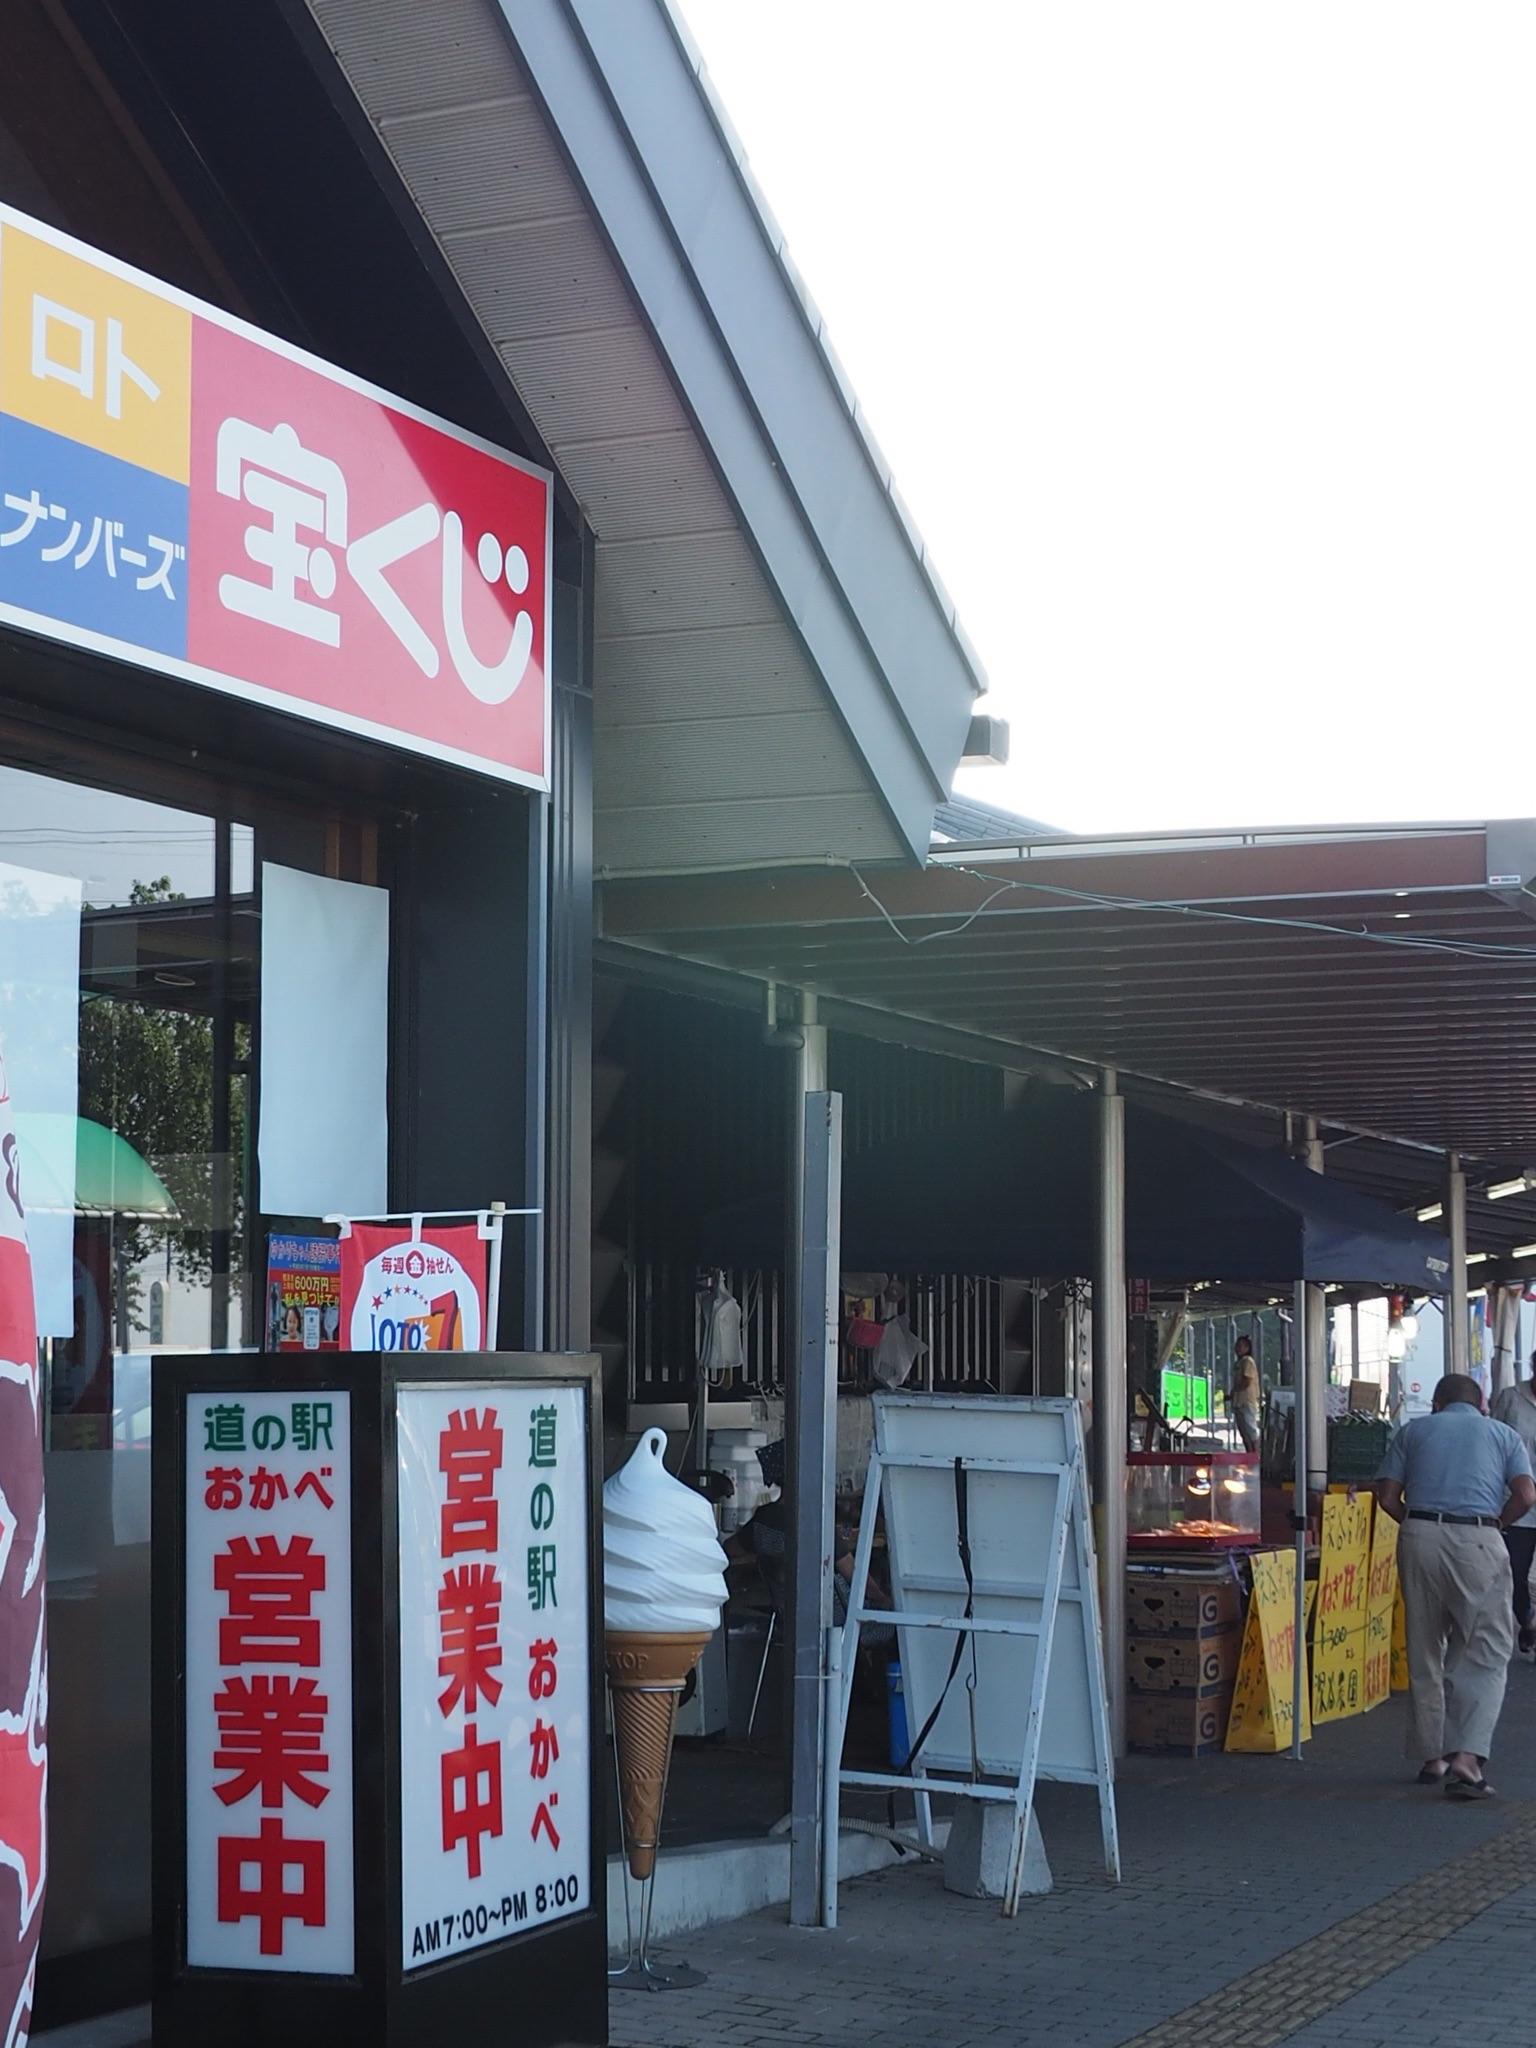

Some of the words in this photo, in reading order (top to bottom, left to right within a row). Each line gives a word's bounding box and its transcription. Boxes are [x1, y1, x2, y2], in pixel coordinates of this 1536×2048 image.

[32, 293, 161, 420] ロト
[0, 489, 185, 600] ナンバーズ
[216, 417, 533, 705] 宝くじ
[204, 1402, 334, 1451] 道の駅
[205, 1466, 334, 1510] おかべ
[528, 1403, 558, 1611] 道の駅
[438, 1407, 504, 1878] 営業中
[212, 1535, 330, 1955] 営業中
[529, 1637, 559, 1854] おかべ
[535, 1875, 579, 1913] 8:00
